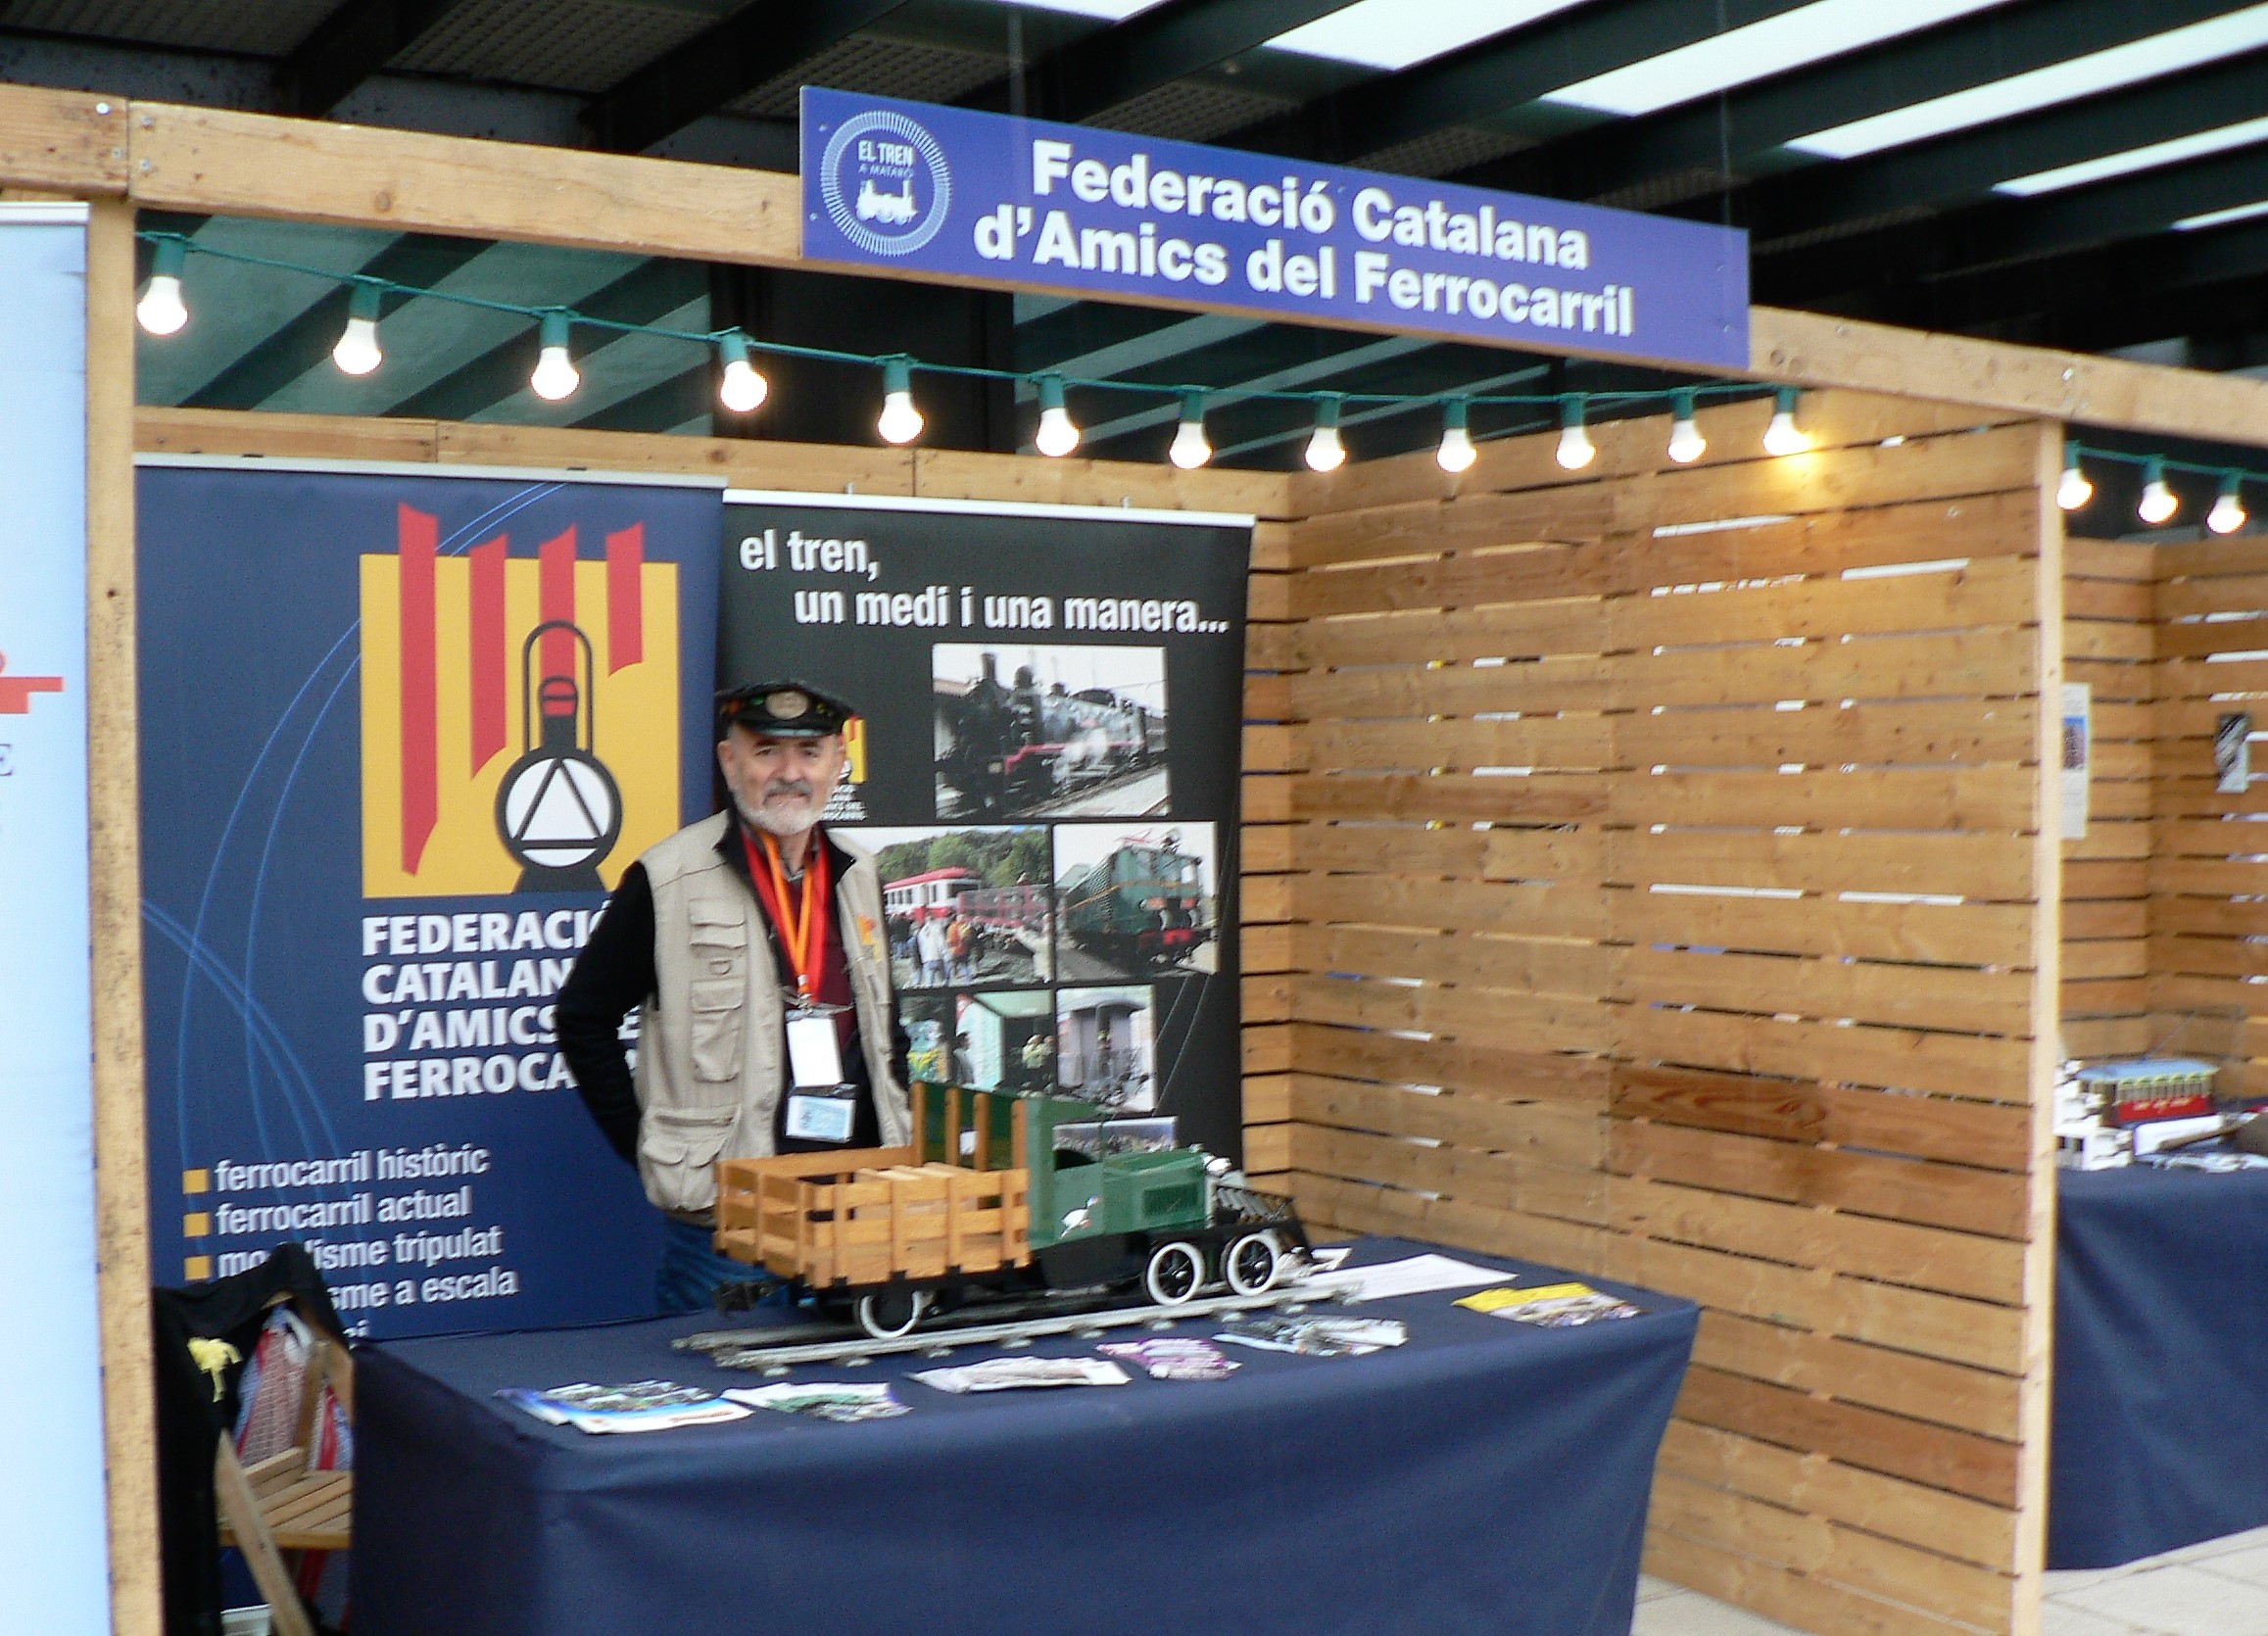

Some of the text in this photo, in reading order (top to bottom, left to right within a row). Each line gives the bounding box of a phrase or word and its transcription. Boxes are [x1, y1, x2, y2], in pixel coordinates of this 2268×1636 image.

[858, 140, 914, 168] EL TREN
[1033, 138, 1590, 271] Federació Catalana
[973, 203, 1635, 338] d'Amics del Ferrocarril
[740, 529, 881, 583] el tren,
[794, 585, 1231, 634] un medi i una manera...
[362, 956, 577, 1005] CATALAN
[363, 1051, 580, 1102] FERROCA
[215, 1142, 491, 1193] ferrocarril històric
[215, 1184, 473, 1235] ferrocarril actual
[217, 1225, 505, 1279] moisme tripulat
[395, 1278, 417, 1306] a
[421, 1266, 520, 1304] escala
